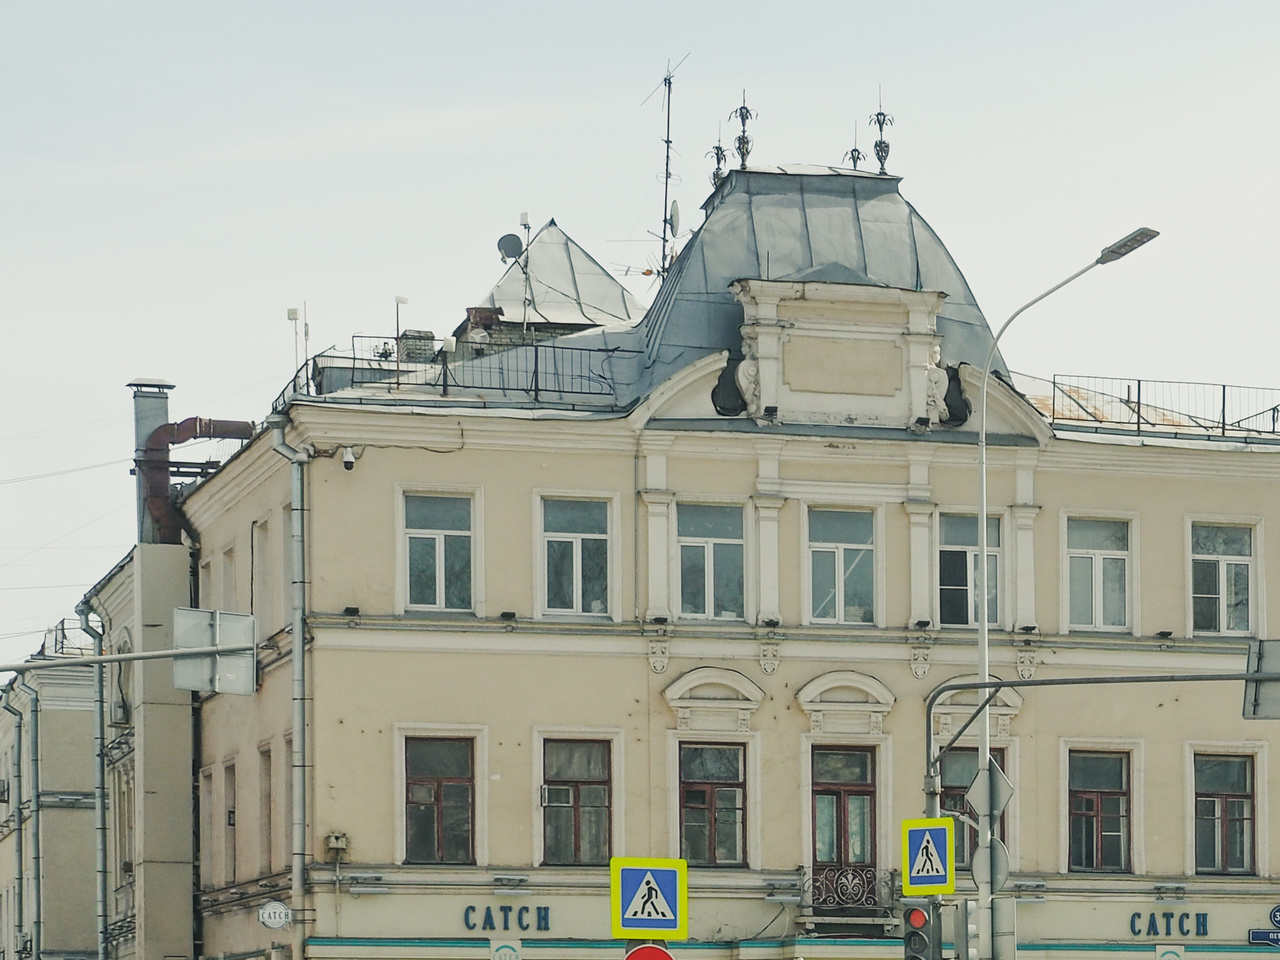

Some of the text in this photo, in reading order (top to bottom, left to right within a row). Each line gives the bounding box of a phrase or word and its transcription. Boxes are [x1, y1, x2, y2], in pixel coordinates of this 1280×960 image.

[261, 911, 290, 921] CATCH
[464, 905, 551, 931] CATCH
[1130, 912, 1208, 936] CATCH
